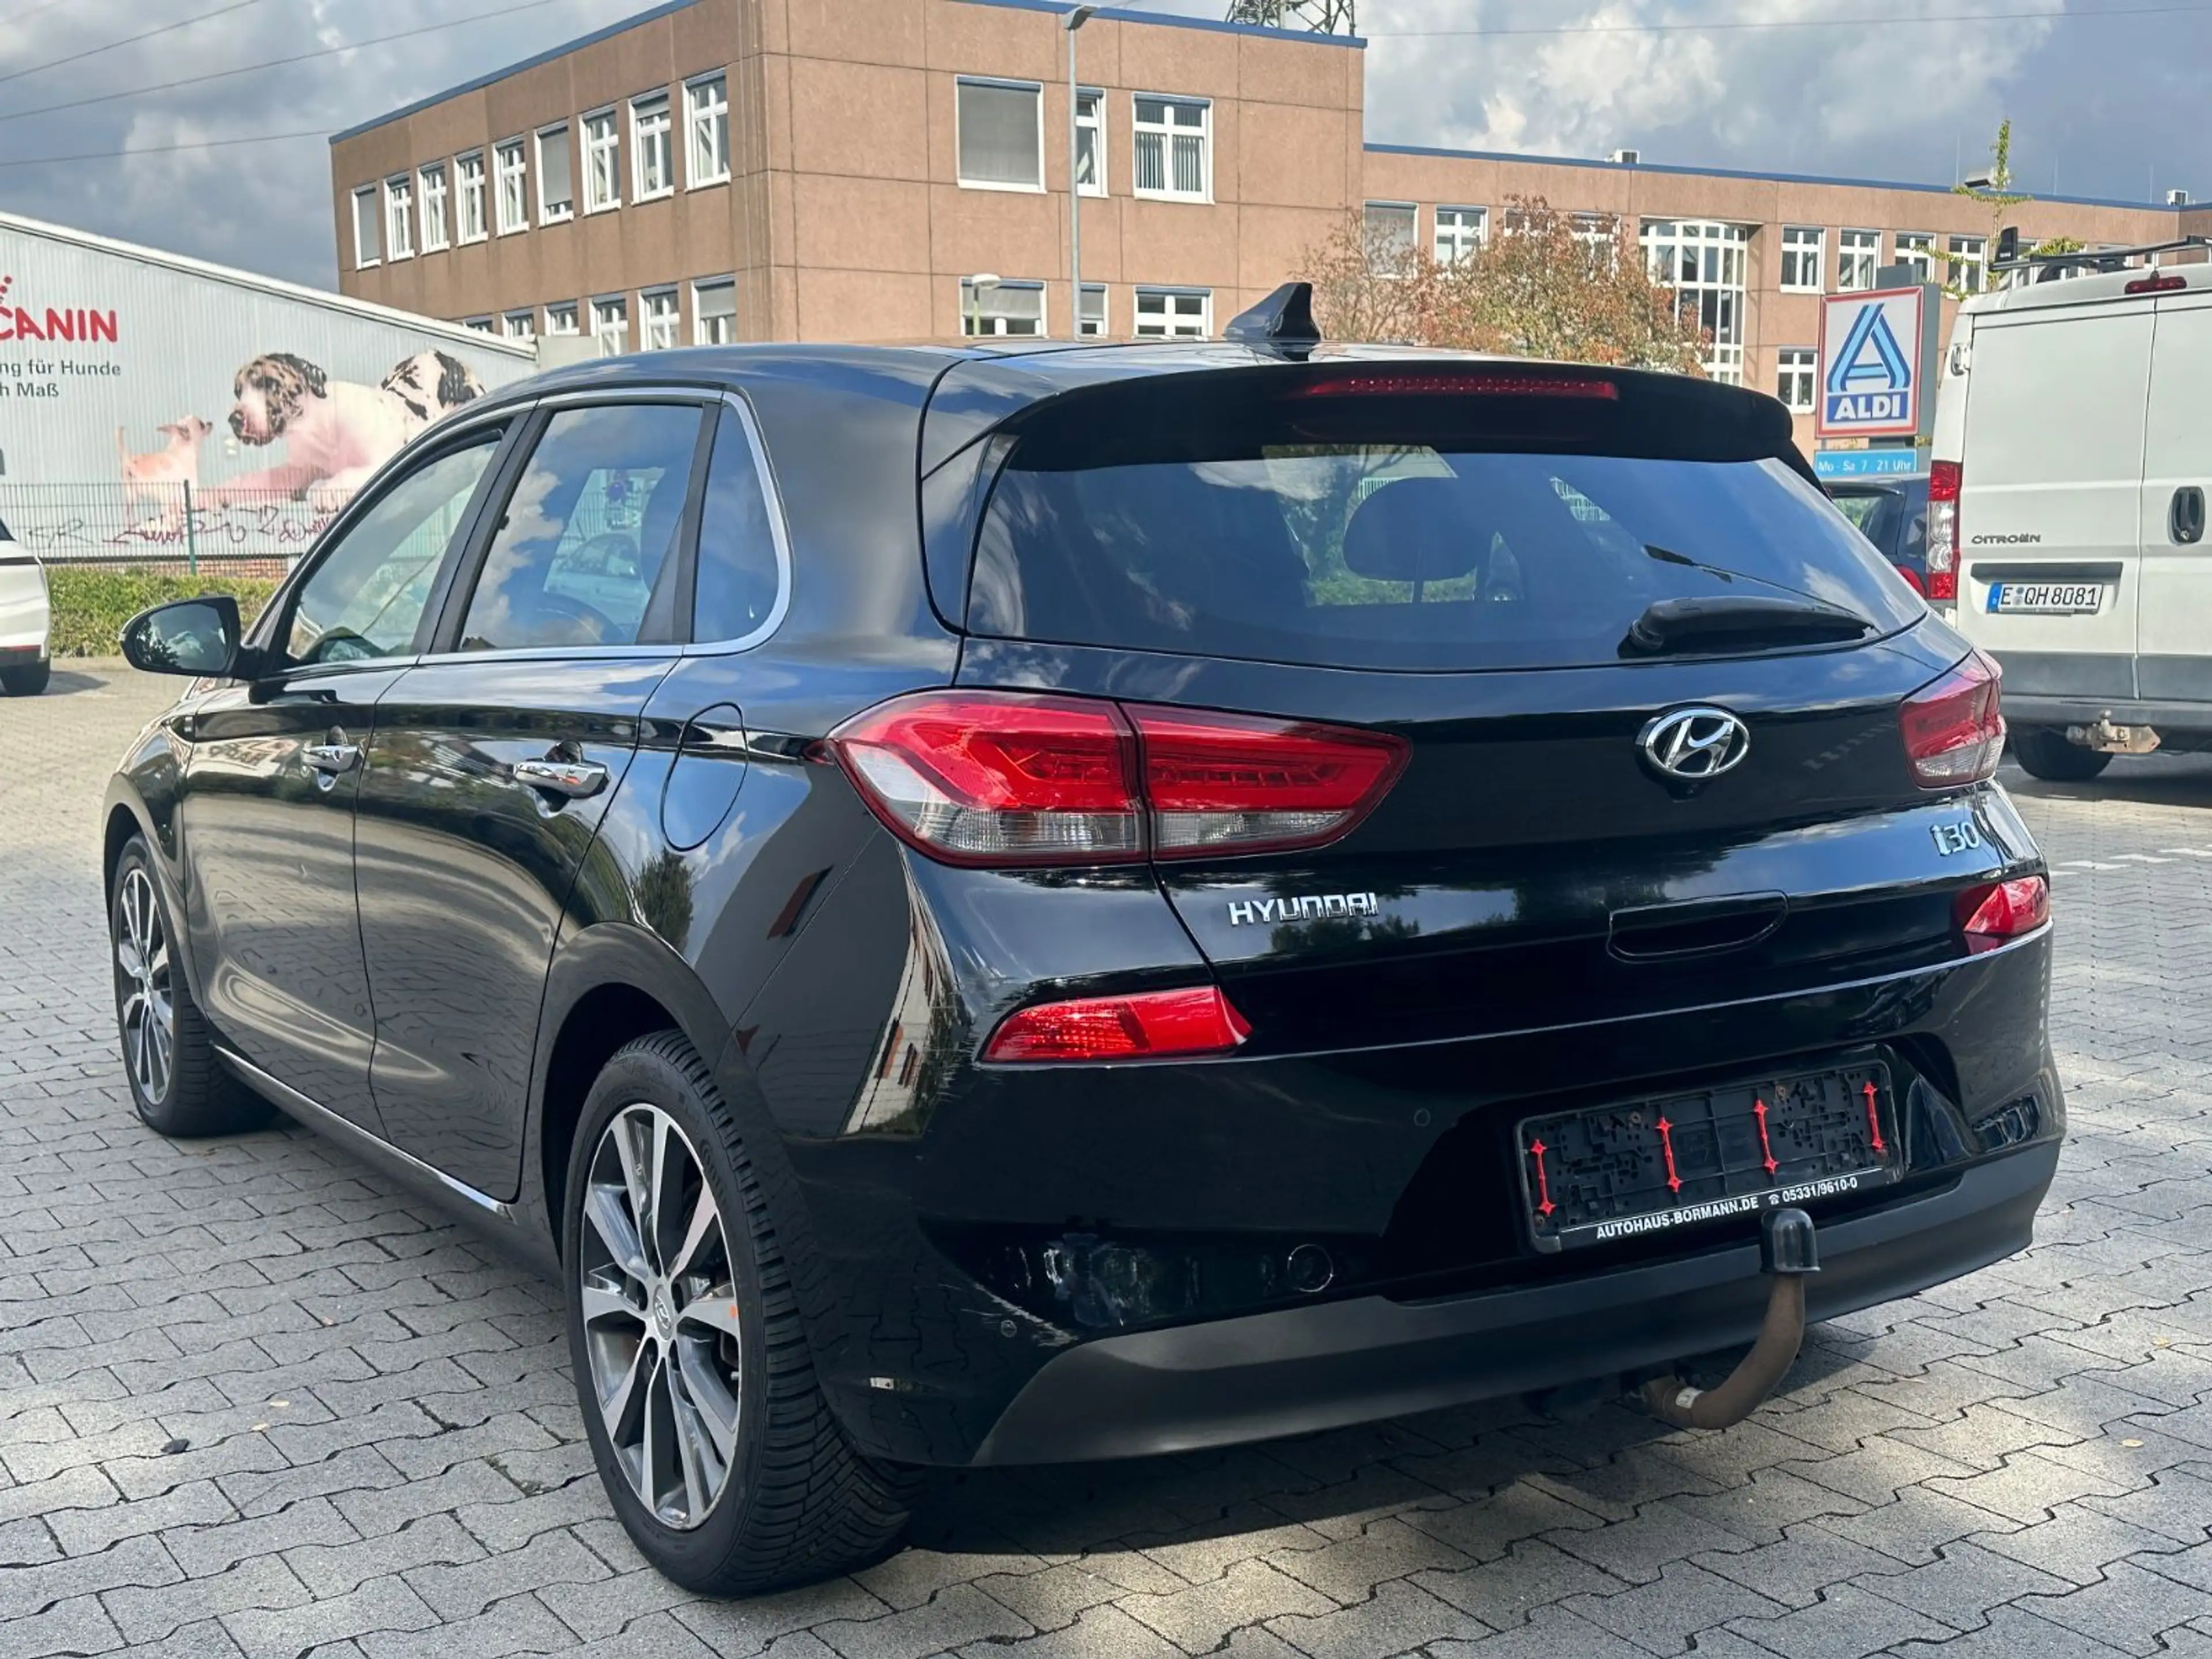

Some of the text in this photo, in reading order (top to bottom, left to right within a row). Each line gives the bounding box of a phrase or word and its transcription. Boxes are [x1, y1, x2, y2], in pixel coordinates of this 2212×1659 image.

[28, 359, 54, 374] für
[61, 359, 121, 376] Hunde
[17, 382, 59, 397] Maß
[1834, 394, 1901, 420] ALDI
[1819, 461, 1834, 471] Mo
[1843, 460, 1855, 471] Sa
[1862, 460, 1868, 471] 7
[1877, 460, 1888, 471] 21
[1893, 459, 1911, 471] Uhr
[2000, 588, 2013, 605] E
[2051, 587, 2097, 605] 8081
[1931, 821, 1980, 856] i30
[1228, 892, 1378, 925] HYUNDAI
[1782, 1176, 1858, 1203] 05331/9610-0
